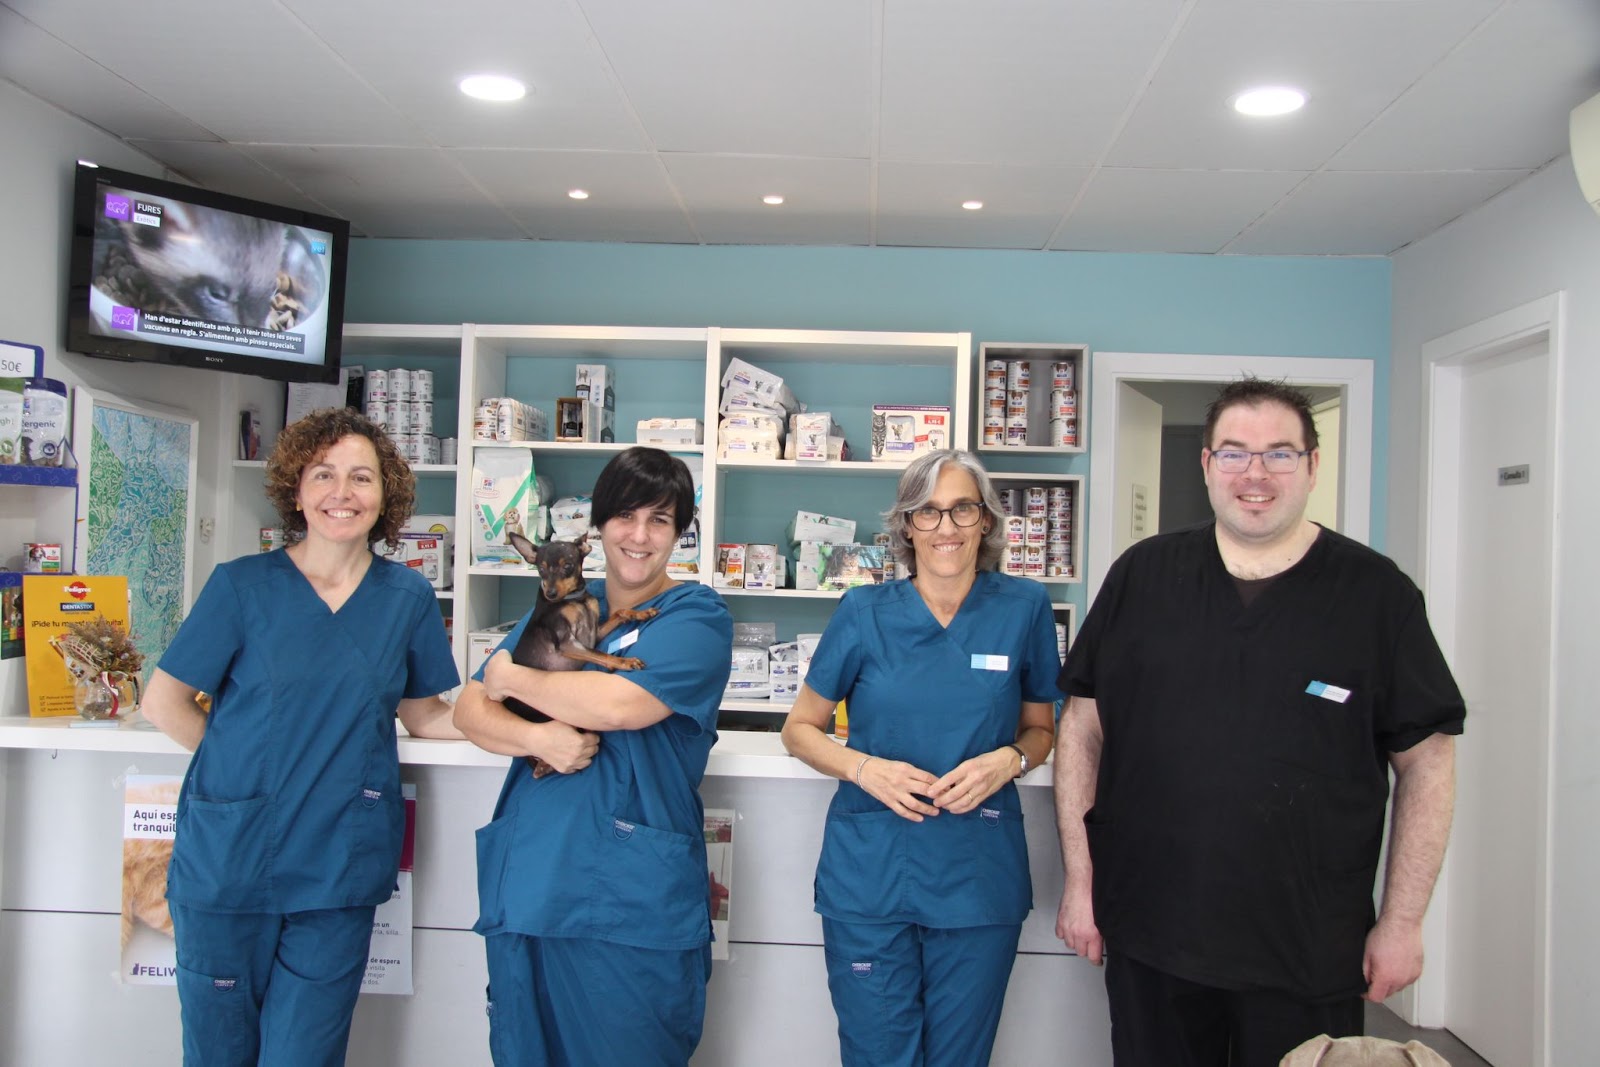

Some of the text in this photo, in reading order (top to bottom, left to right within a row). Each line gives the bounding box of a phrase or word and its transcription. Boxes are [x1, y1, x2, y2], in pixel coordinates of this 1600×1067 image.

[137, 203, 162, 215] FURES
[144, 313, 158, 321] Han
[159, 316, 181, 324] d'estar
[182, 319, 217, 330] identificats
[261, 331, 276, 339] totes
[277, 332, 285, 340] les
[286, 335, 302, 343] seves
[144, 324, 170, 333] vacunes
[180, 328, 198, 337] regla.
[199, 330, 235, 341] S'alimenten
[249, 338, 268, 346] pinsos
[269, 341, 296, 350] especials.
[32, 620, 50, 628] ¡Pide
[133, 809, 158, 821] Aquí
[133, 823, 177, 834] tranquil
